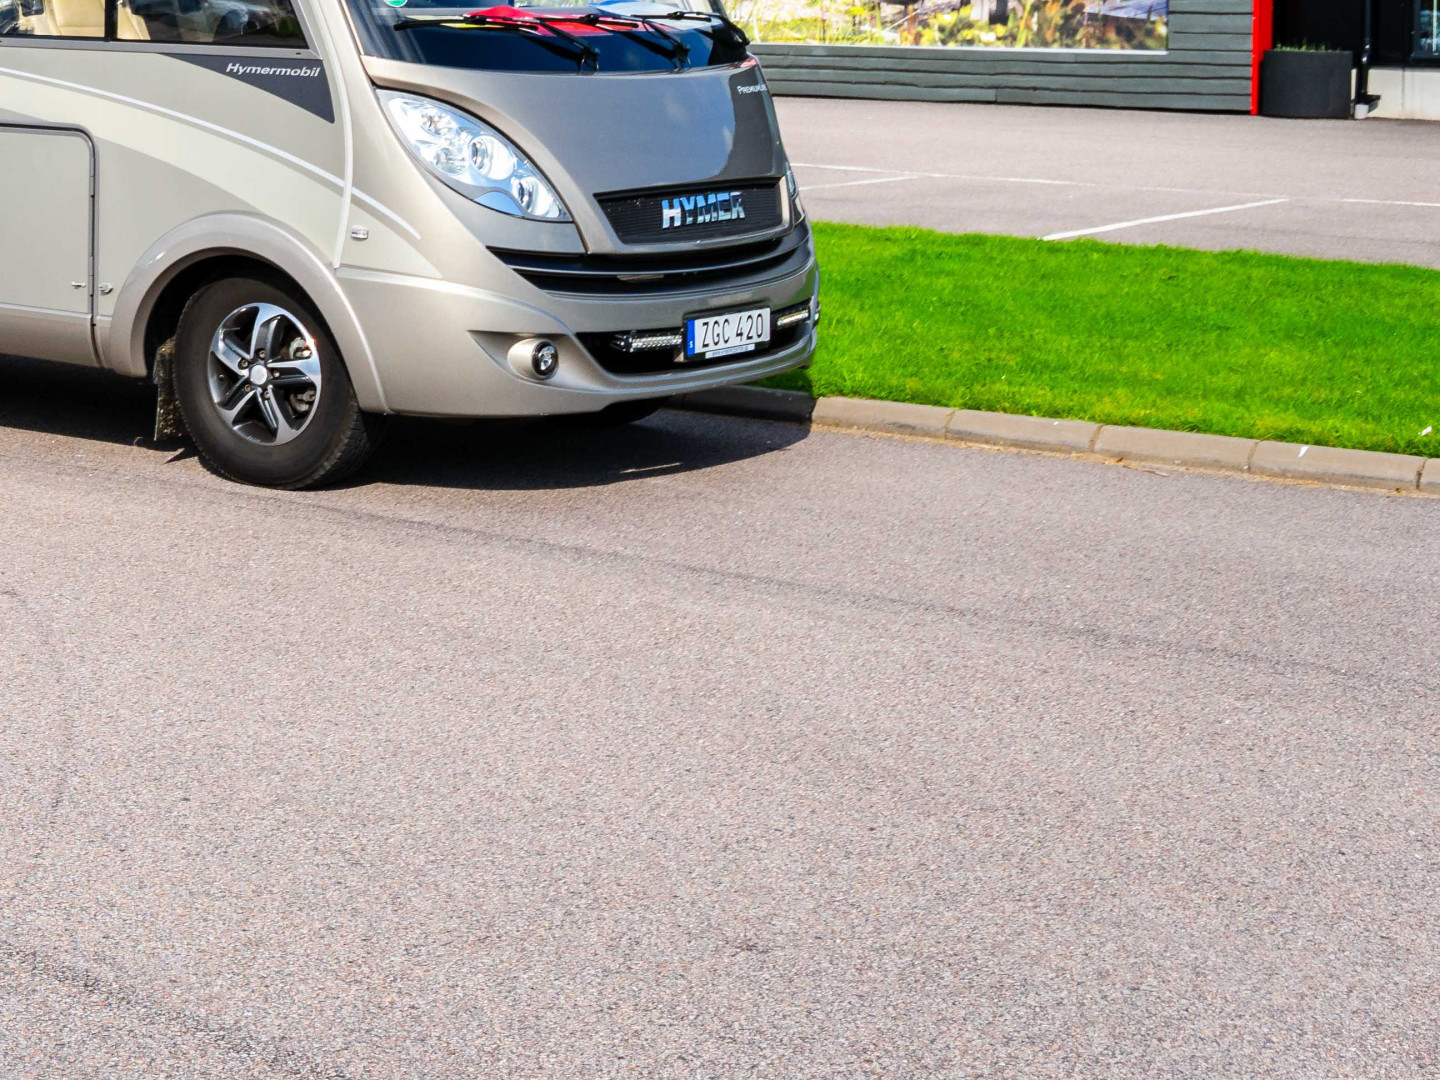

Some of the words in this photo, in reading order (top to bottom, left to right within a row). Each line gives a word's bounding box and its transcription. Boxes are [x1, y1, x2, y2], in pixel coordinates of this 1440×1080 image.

[226, 62, 320, 77] Hymermobil
[661, 191, 746, 229] HYMER
[702, 318, 730, 349] ZGC
[735, 313, 764, 342] 420
